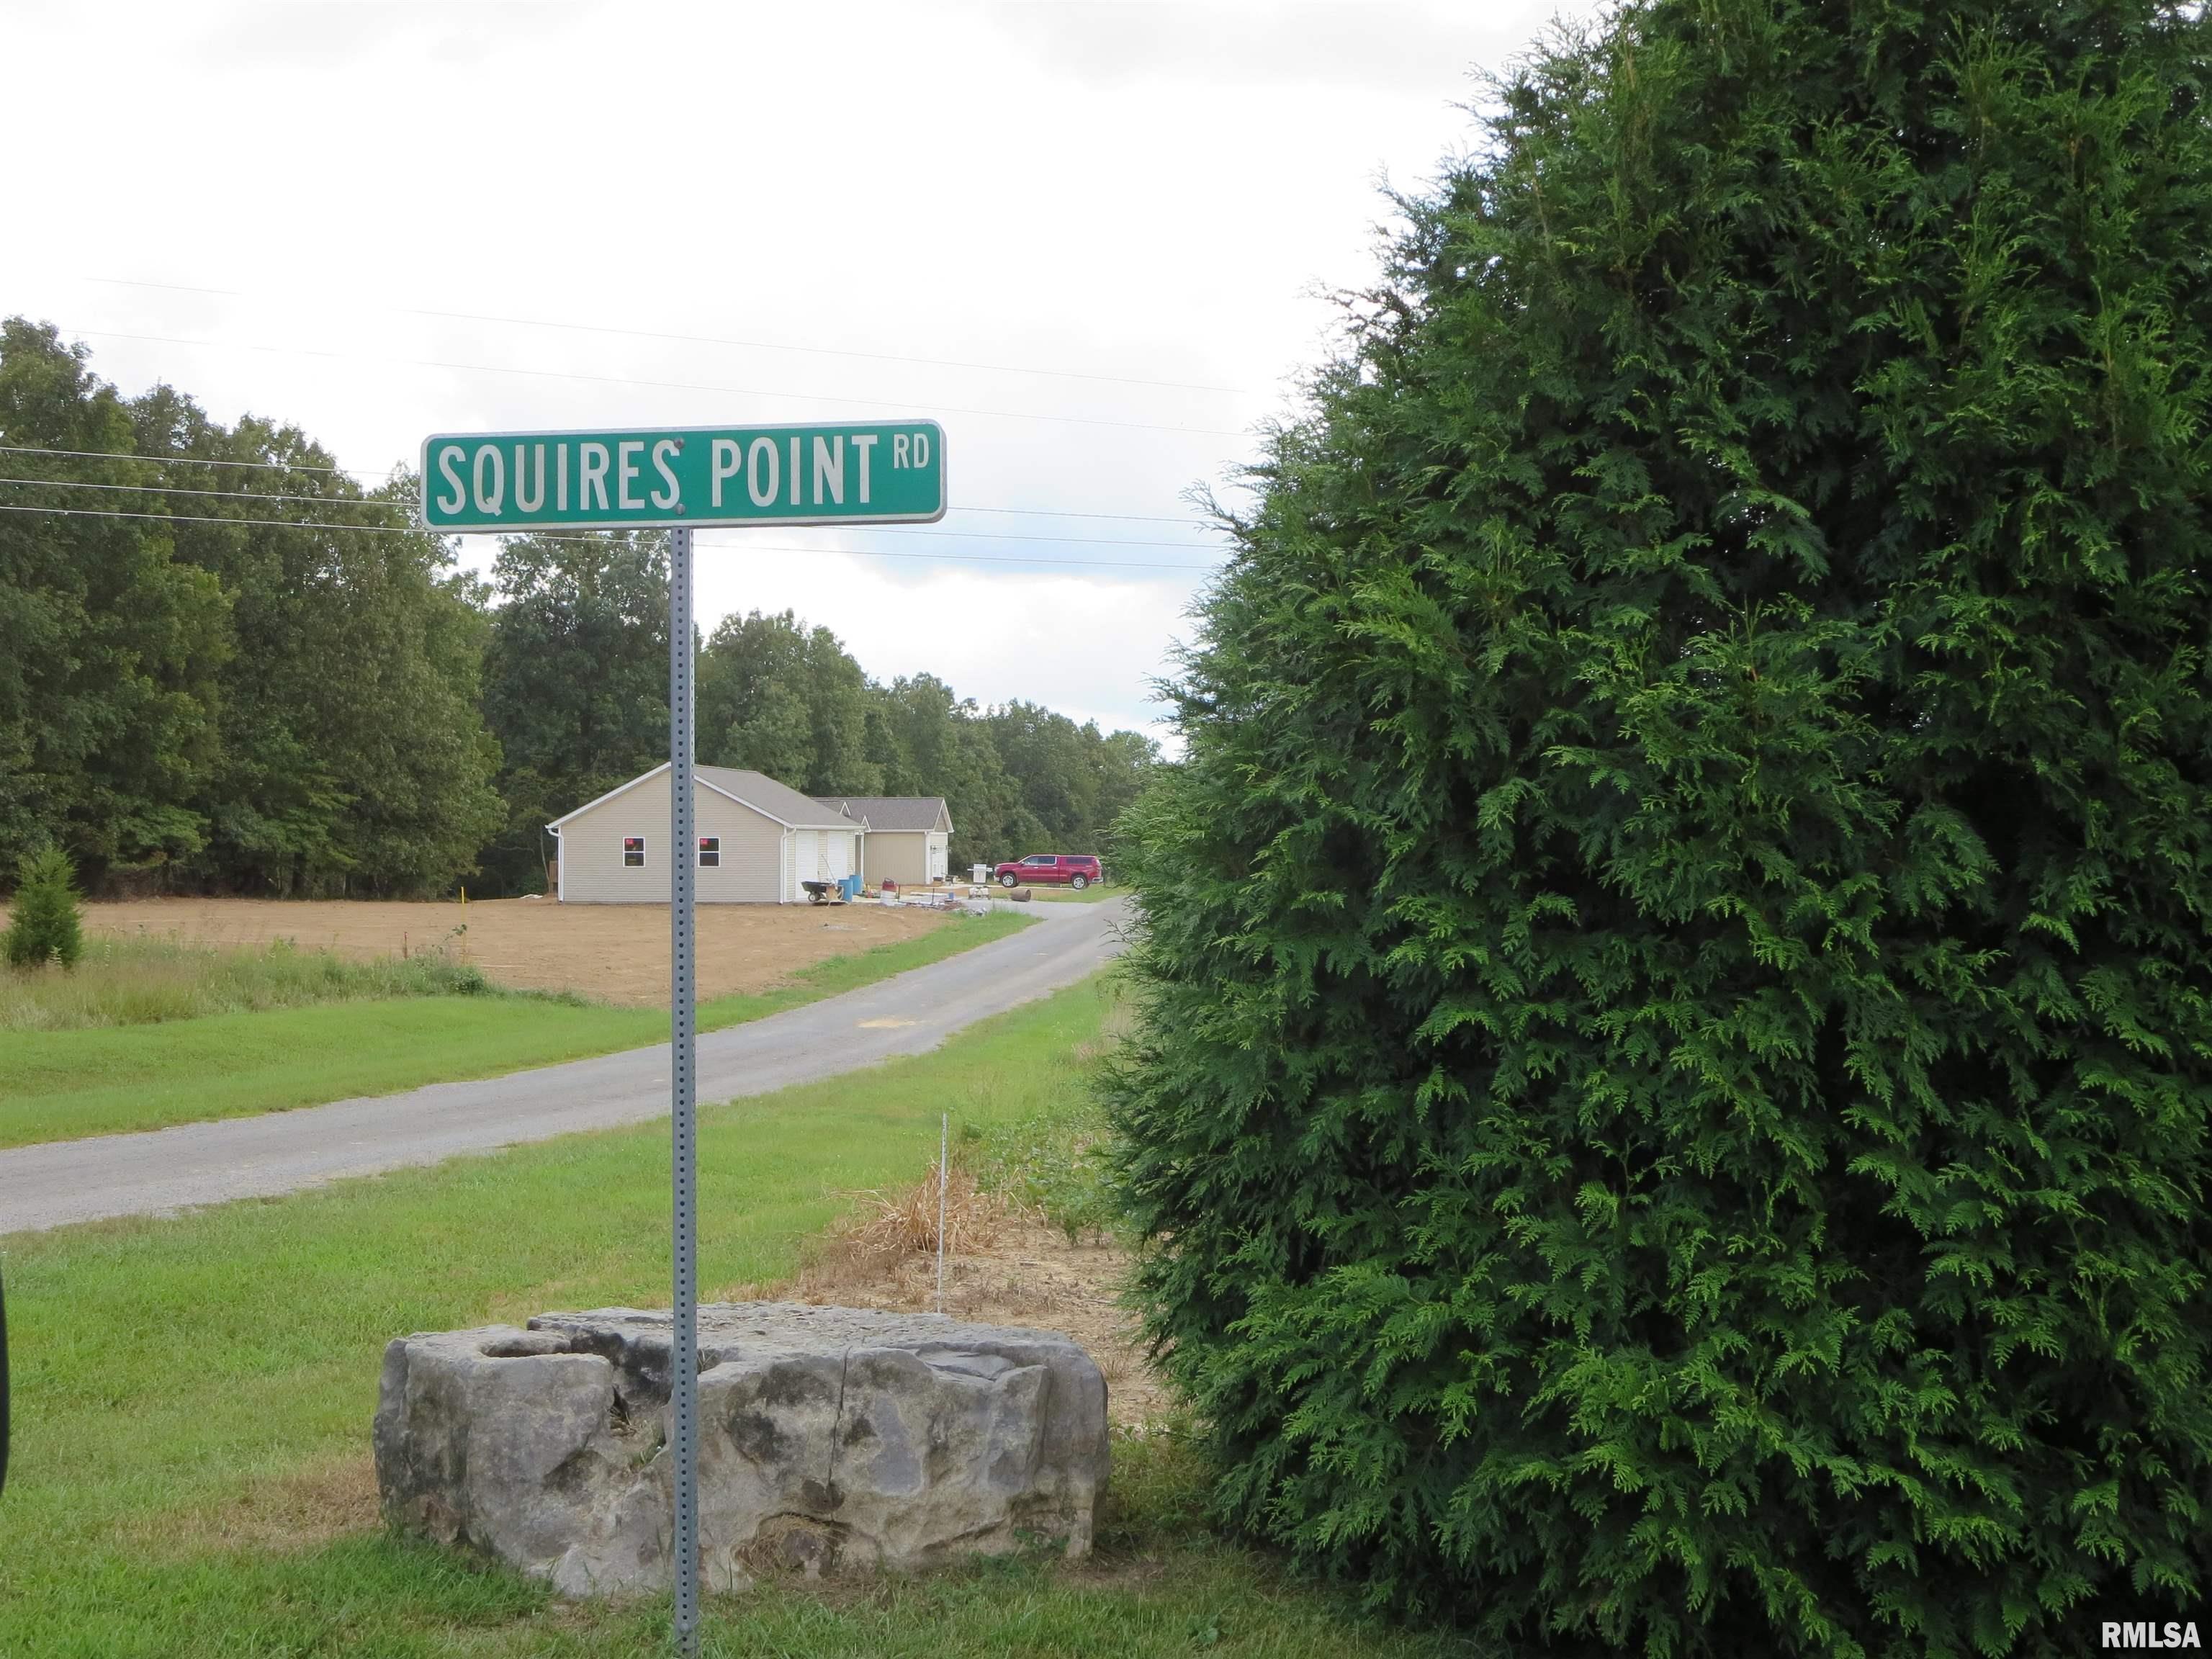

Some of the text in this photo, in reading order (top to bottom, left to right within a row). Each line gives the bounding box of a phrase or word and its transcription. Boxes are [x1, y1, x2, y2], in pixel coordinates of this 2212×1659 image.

[437, 433, 929, 516] SQUIRES POINT RD
